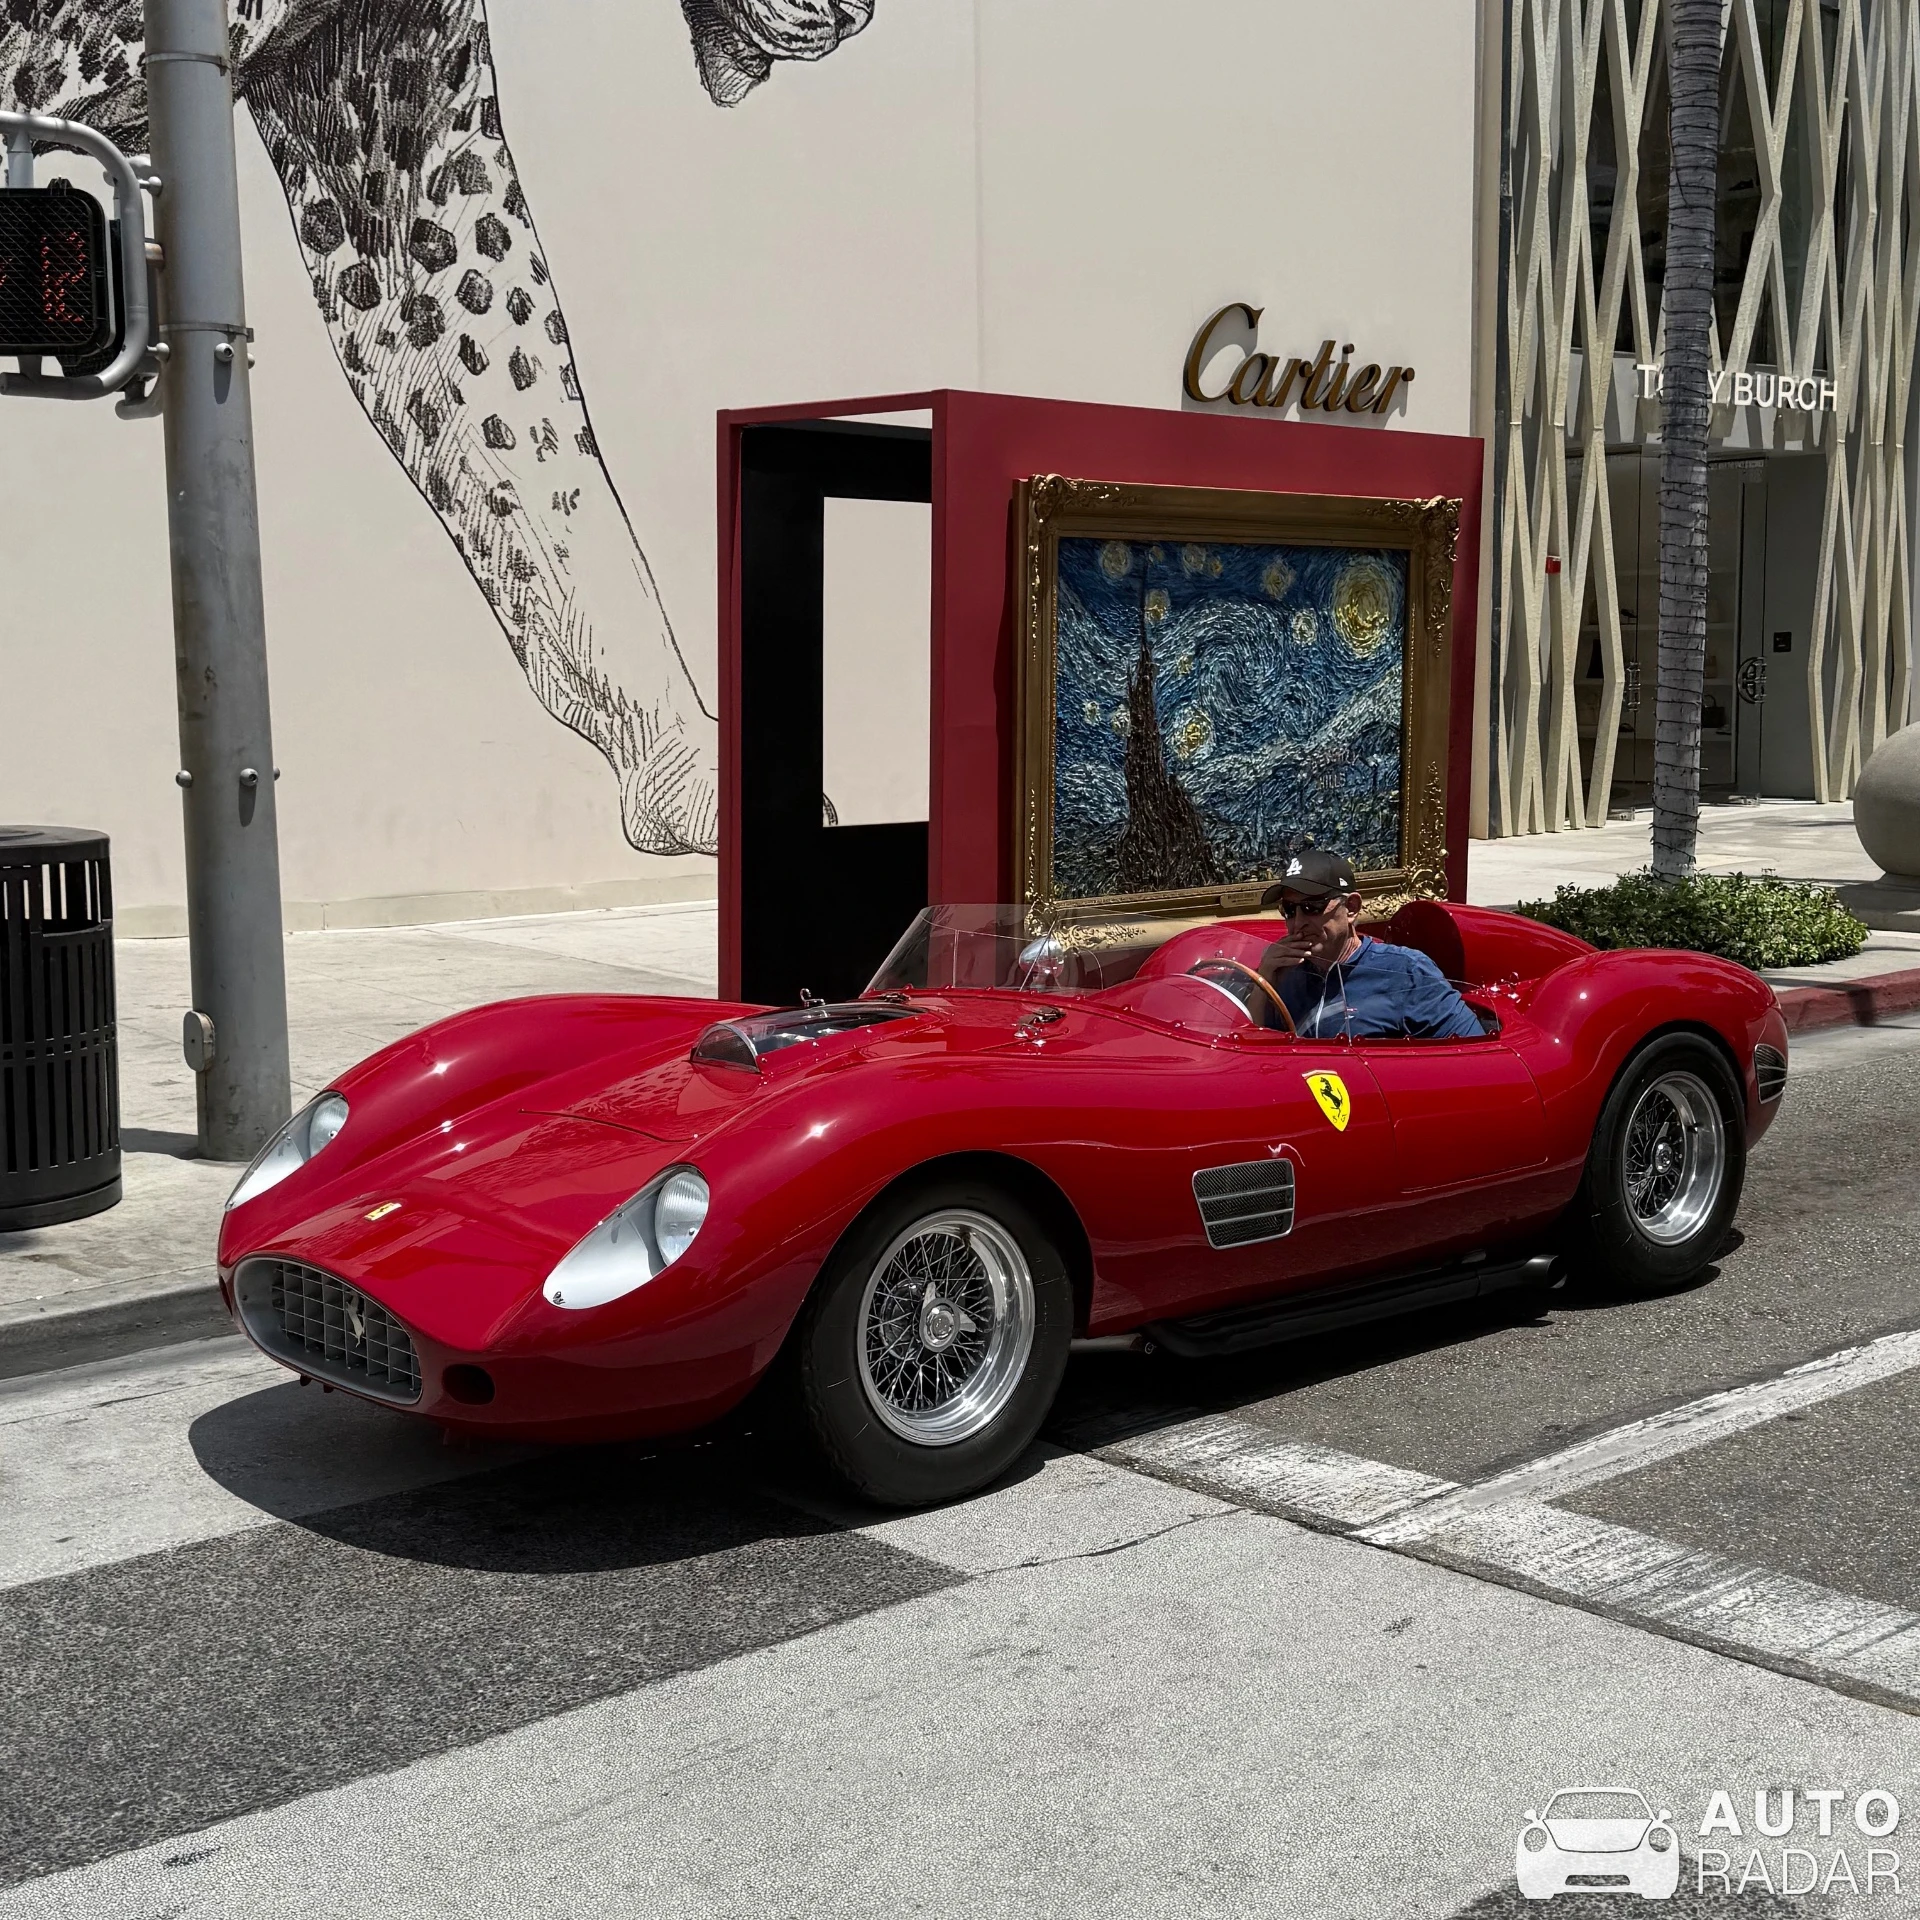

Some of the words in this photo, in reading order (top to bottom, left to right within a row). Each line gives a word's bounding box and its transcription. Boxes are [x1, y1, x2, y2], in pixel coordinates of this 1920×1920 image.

[1182, 302, 1416, 414] Cartier
[1635, 363, 1726, 404] TY
[1733, 371, 1839, 412] BURCH
[1286, 857, 1303, 877] LA
